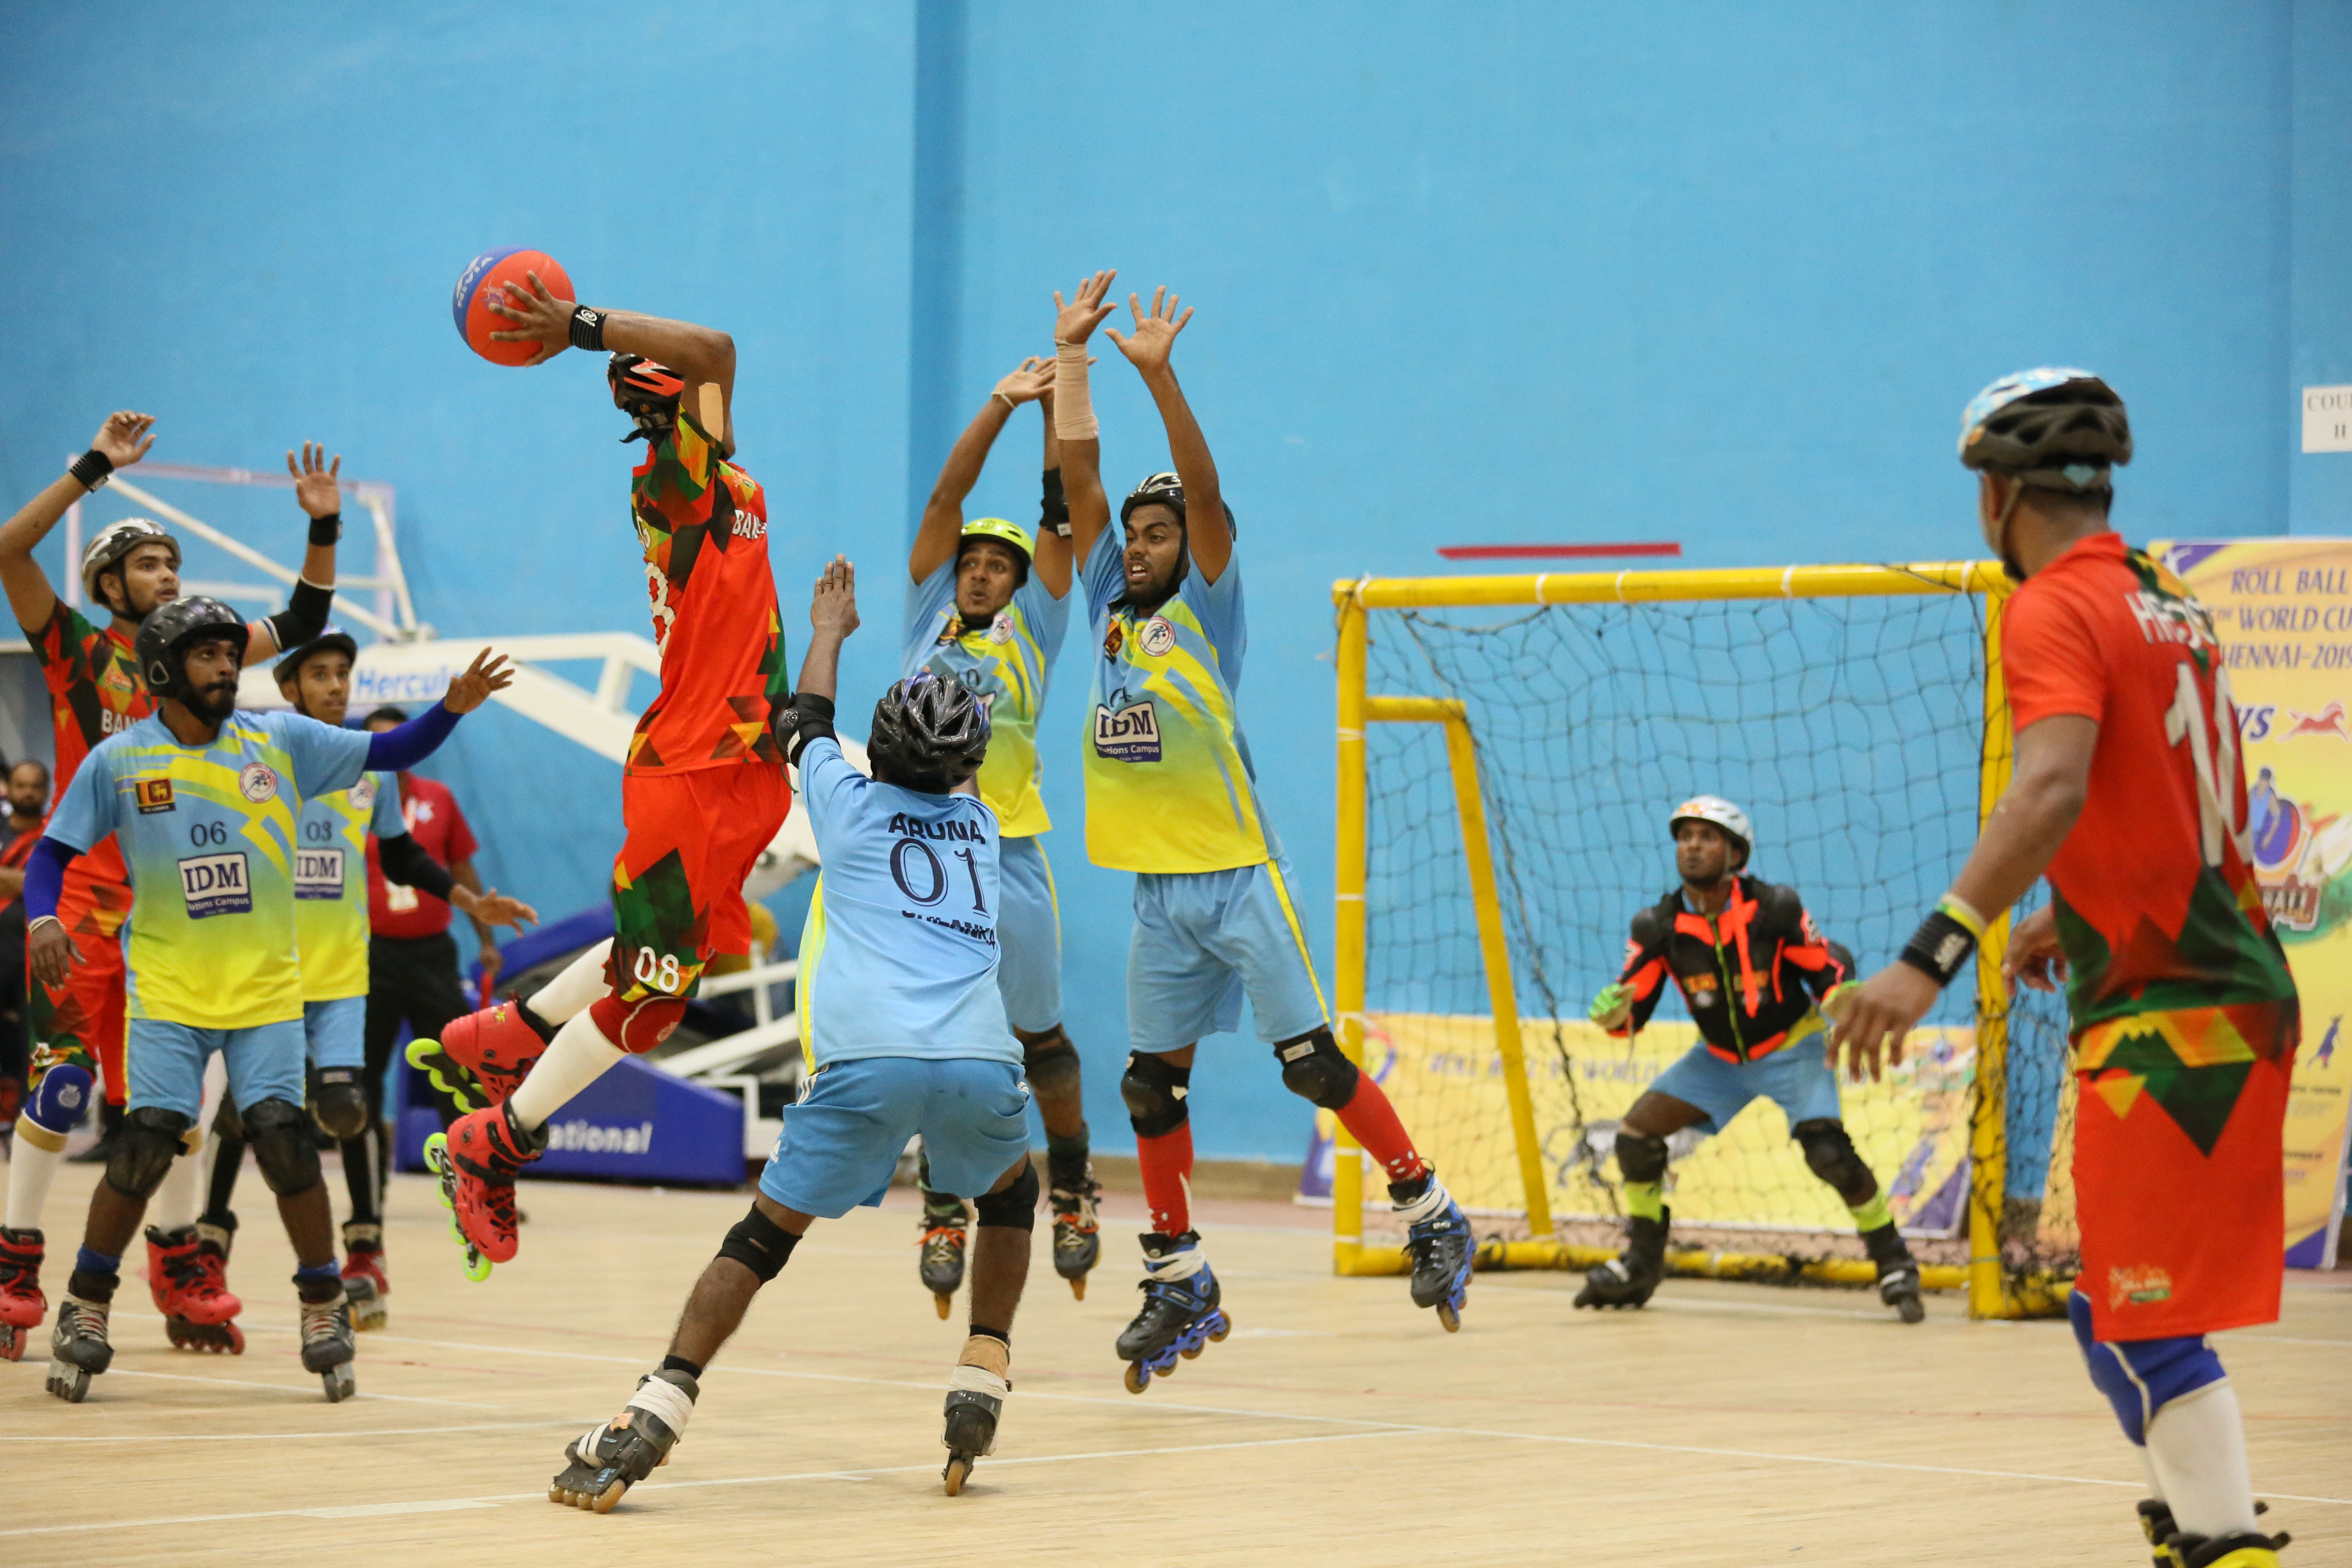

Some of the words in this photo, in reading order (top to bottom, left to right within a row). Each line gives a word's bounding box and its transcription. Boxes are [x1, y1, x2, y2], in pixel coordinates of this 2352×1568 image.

[2230, 567, 2283, 595] ROLL
[2295, 567, 2349, 595] BALL
[2238, 605, 2319, 632] WORLD
[2323, 605, 2352, 633] CU
[2222, 642, 2352, 669] HENNAI-201
[356, 665, 461, 697] Hercul
[101, 708, 141, 735] BAN
[1099, 710, 1154, 738] IDM
[1130, 745, 1160, 754] Campus
[191, 821, 227, 847] 06
[888, 812, 986, 845] ARUNA
[184, 862, 242, 893] IDM
[297, 857, 337, 877] IDM
[889, 837, 991, 919] 01
[215, 897, 249, 906] Campus
[634, 946, 680, 993] 08
[547, 1119, 653, 1155] ational
